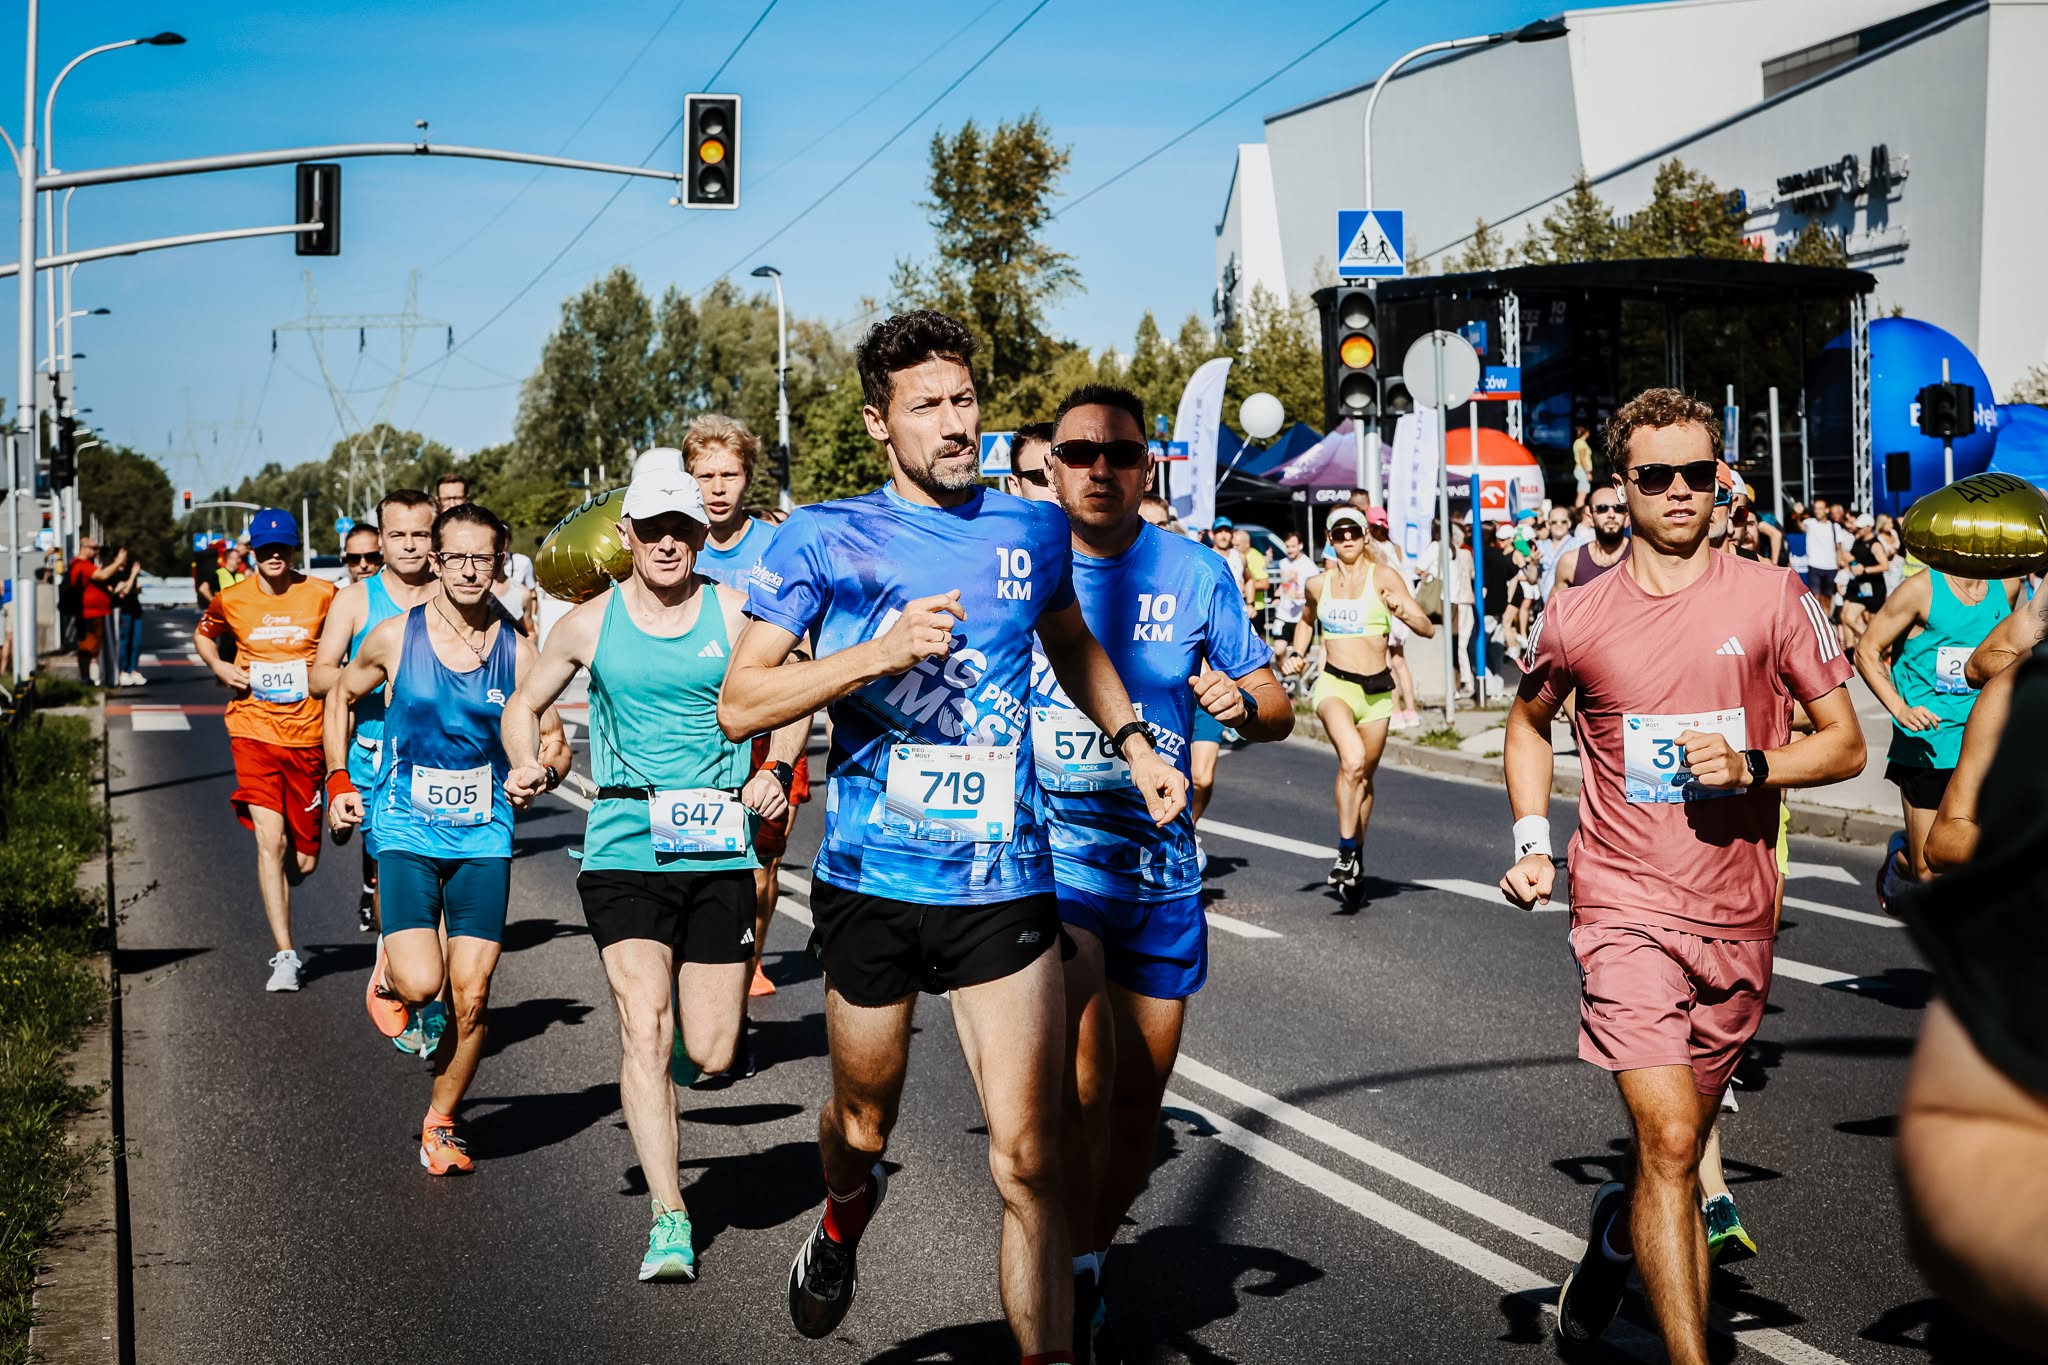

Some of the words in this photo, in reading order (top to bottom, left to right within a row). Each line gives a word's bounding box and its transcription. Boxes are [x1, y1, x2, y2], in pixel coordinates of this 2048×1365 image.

[996, 547, 1032, 579] 10
[997, 579, 1032, 601] KM
[1137, 594, 1177, 623] 10
[1328, 609, 1358, 622] 440
[1133, 623, 1174, 642] KM
[262, 673, 294, 688] 814
[974, 682, 1029, 733] PRZE
[1055, 731, 1118, 760] 576
[1077, 764, 1099, 772] JACEK
[427, 784, 478, 806] 505
[920, 770, 986, 805] 719
[671, 802, 725, 827] 647
